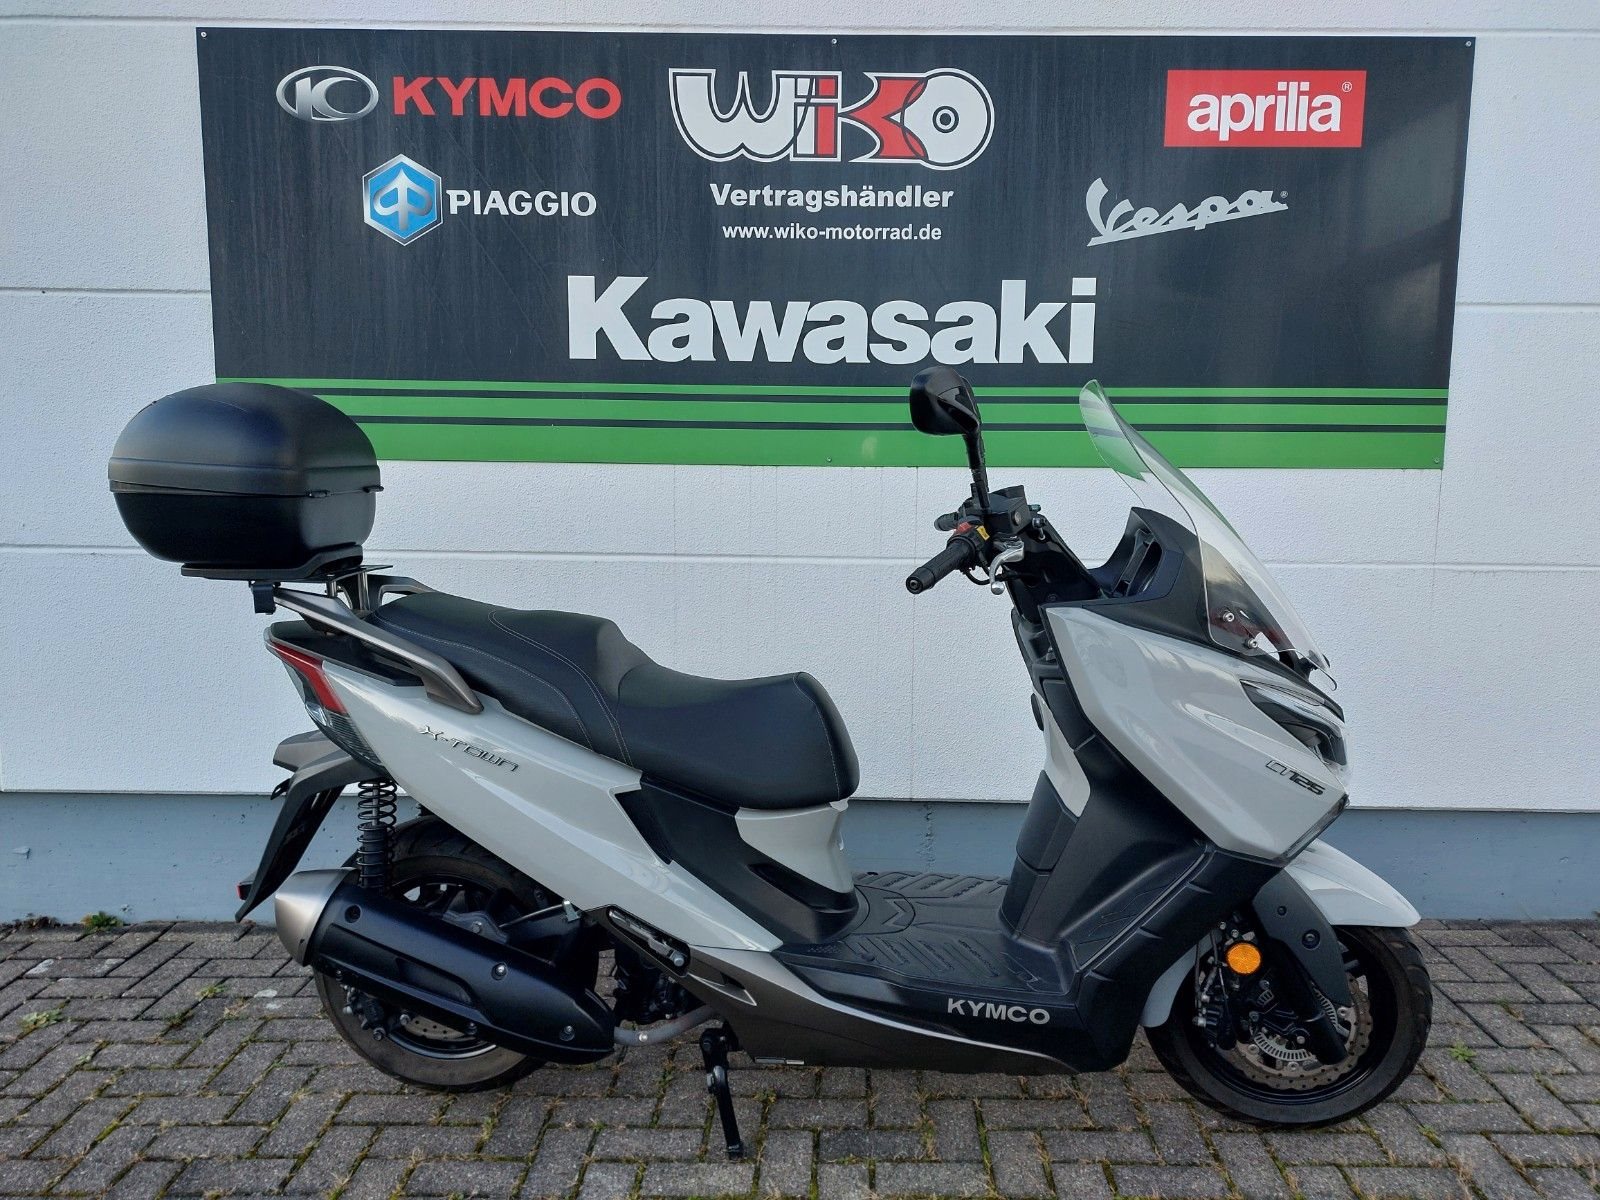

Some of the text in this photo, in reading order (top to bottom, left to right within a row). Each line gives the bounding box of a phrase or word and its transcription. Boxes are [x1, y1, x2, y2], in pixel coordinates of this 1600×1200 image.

[394, 76, 622, 119] KYMCO
[1187, 81, 1342, 141] aprilia
[446, 190, 597, 217] PIAGGIO
[710, 184, 954, 213] Vertragshändler
[1086, 177, 1289, 247] Vespa
[722, 223, 942, 241] www.wiko-motorrad.de
[567, 275, 1097, 365] Kawasaki
[947, 997, 1051, 1026] KYMCO
